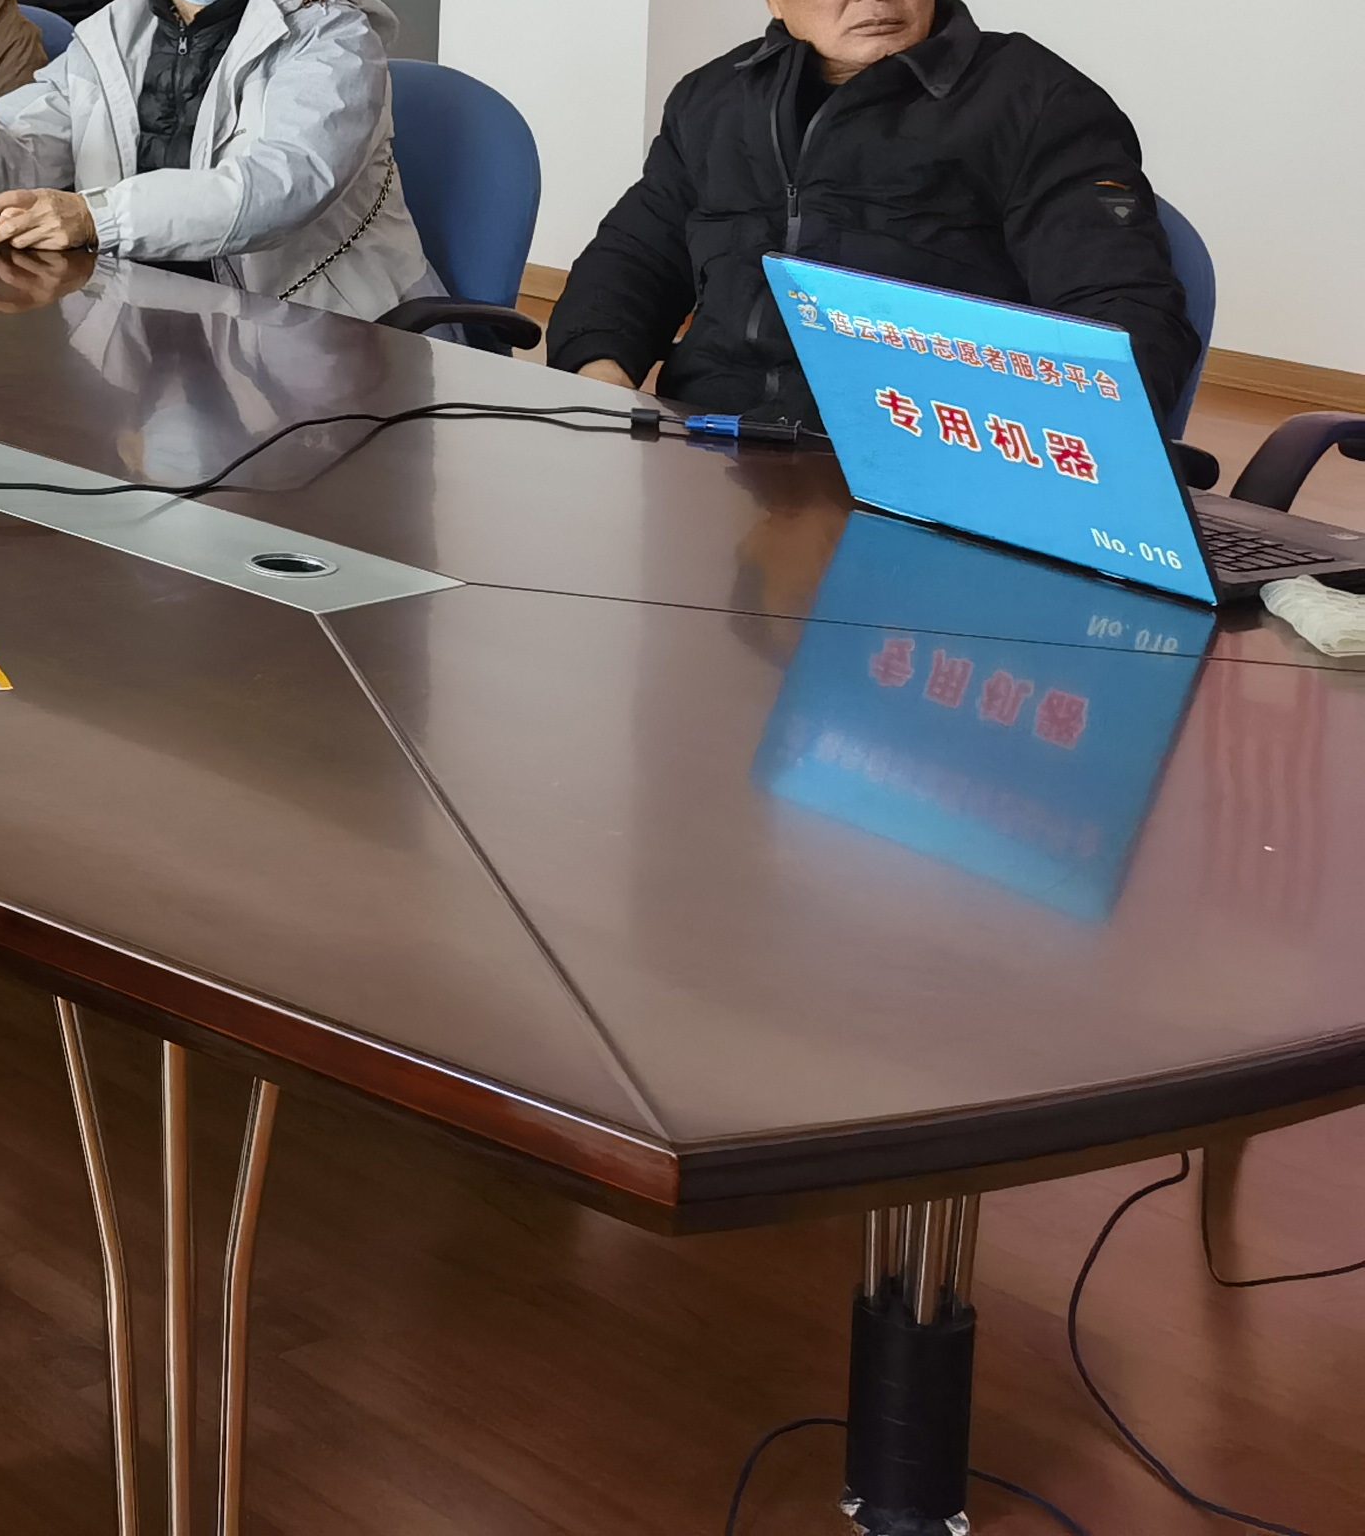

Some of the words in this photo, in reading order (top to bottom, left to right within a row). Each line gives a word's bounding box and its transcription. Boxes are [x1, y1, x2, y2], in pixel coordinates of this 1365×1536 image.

[827, 309, 1122, 402] 连云港市志愿者服务平台
[875, 386, 1100, 485] 专用机器
